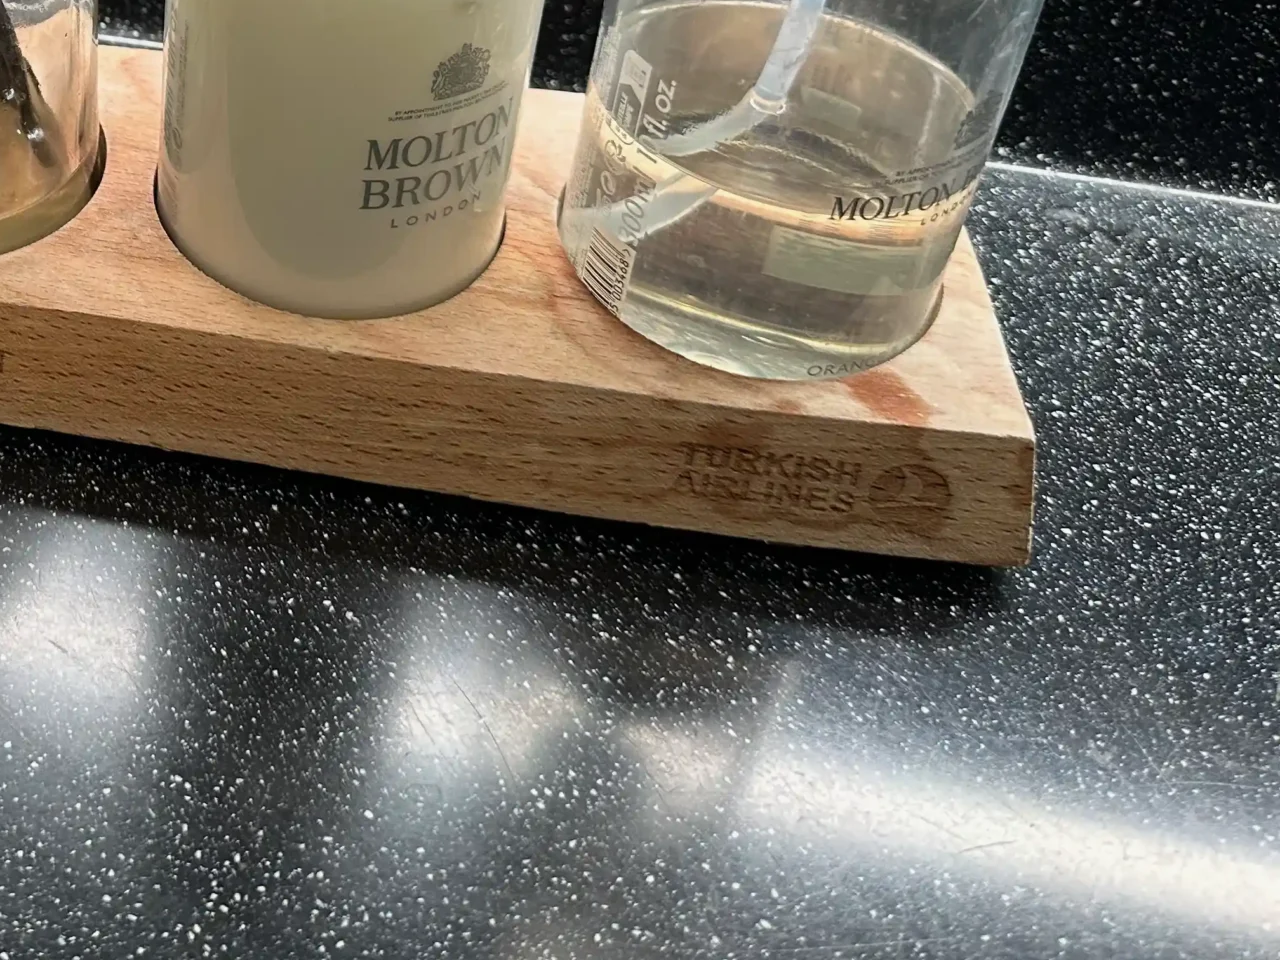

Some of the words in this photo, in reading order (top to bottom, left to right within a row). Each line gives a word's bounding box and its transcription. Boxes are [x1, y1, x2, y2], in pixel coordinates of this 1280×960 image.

[654, 78, 678, 114] oz.
[363, 96, 514, 171] MOLTON
[359, 136, 506, 210] BROWN
[390, 189, 482, 229] LONDON
[828, 177, 957, 221] MOLTON
[680, 441, 862, 486] TURKISH
[673, 470, 856, 513] AIRLINES
